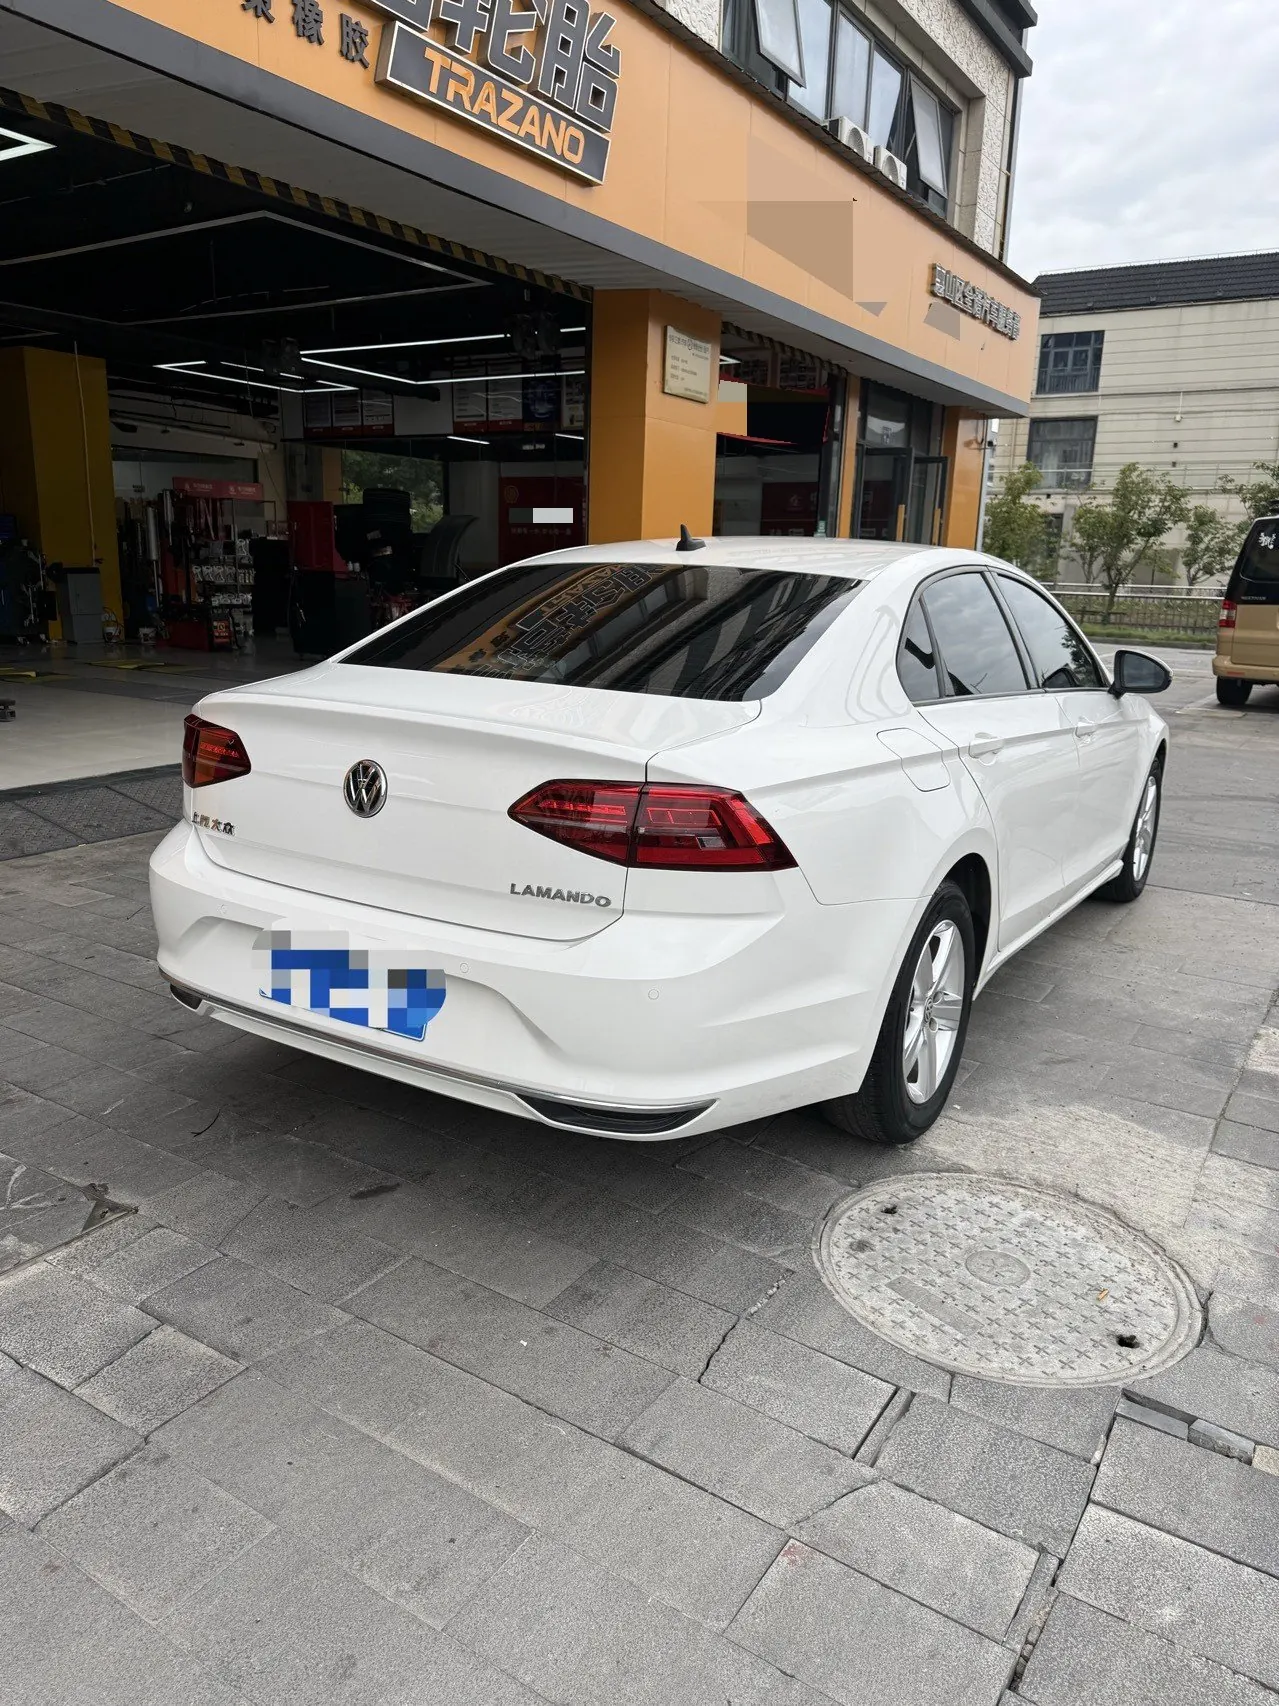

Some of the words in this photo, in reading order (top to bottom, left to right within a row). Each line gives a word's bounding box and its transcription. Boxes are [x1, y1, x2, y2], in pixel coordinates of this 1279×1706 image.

[371, 0, 621, 134] 轮胎
[424, 47, 585, 165] TRAZANO
[191, 811, 235, 836] 上汽大众
[510, 883, 612, 908] LAMANDO
